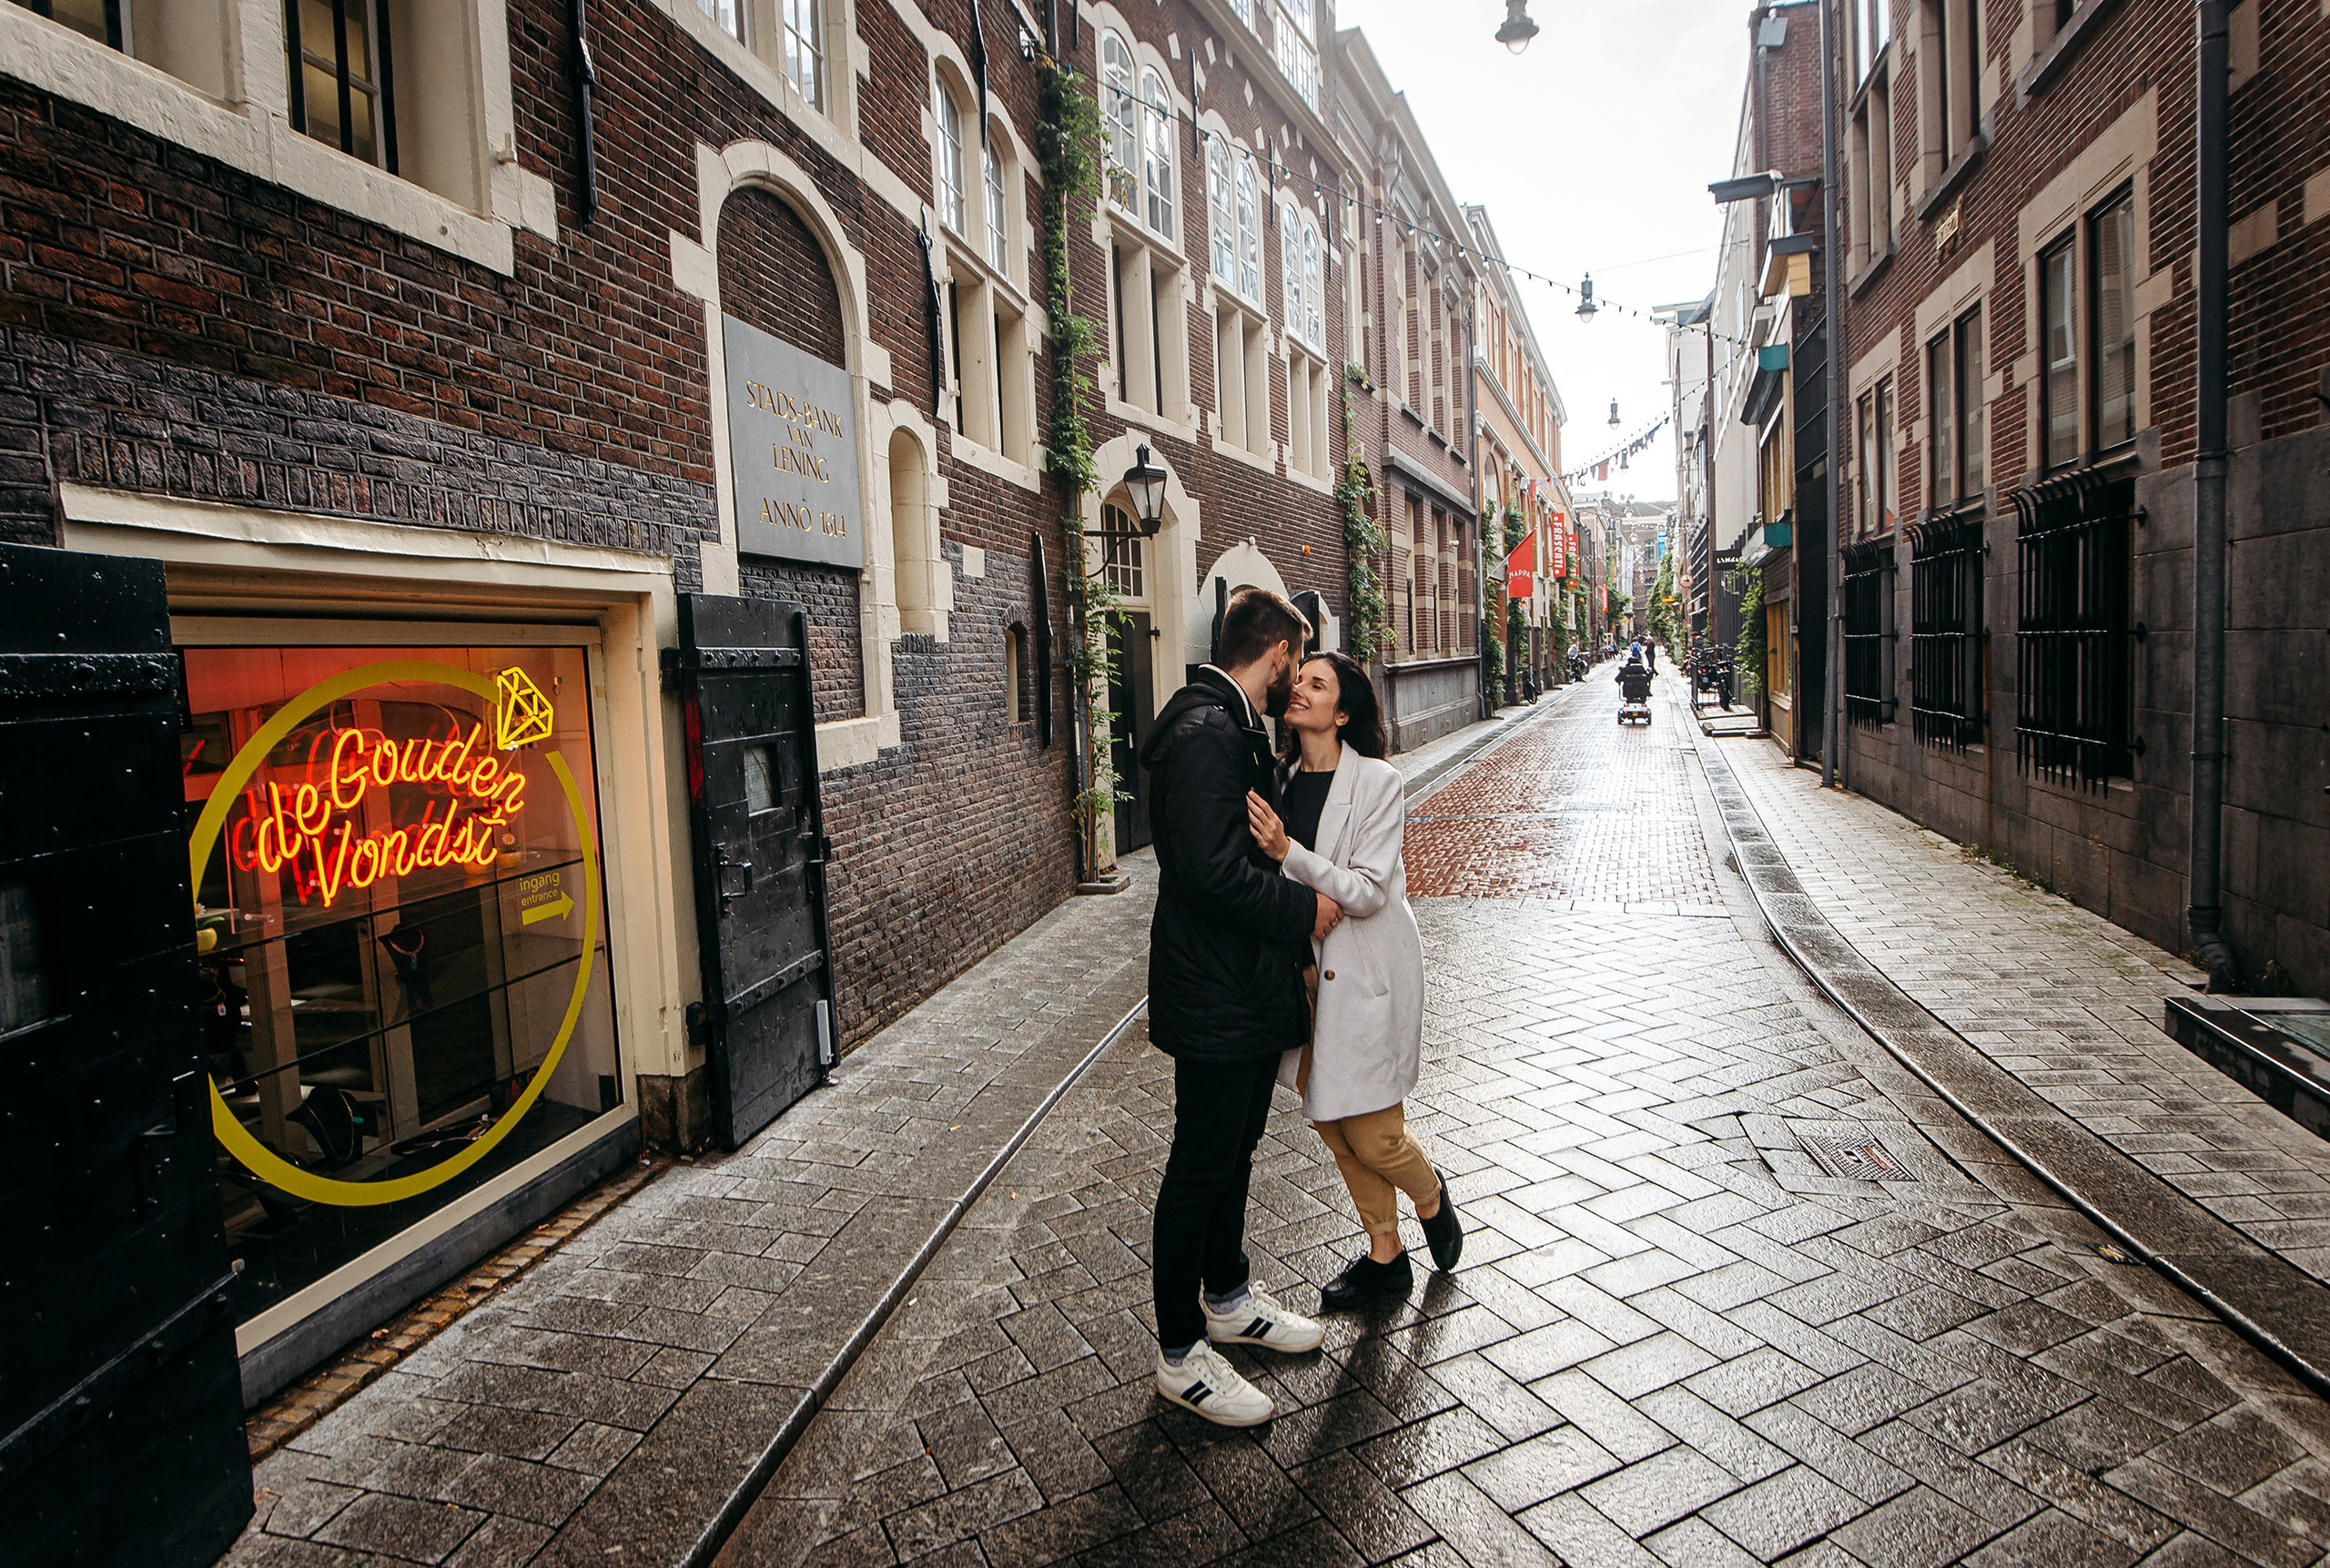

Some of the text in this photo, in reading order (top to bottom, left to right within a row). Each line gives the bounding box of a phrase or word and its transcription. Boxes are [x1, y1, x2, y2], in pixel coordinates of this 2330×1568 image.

[745, 379, 844, 440] STADS-BANK
[786, 424, 815, 451] VAN
[773, 443, 830, 484] LENING
[759, 498, 848, 539] ANNO 1614
[1554, 521, 1564, 569] FRASCATI
[1509, 569, 1531, 579] MAPPA
[258, 721, 526, 874] de Gouden
[311, 797, 507, 908] Vondst
[519, 872, 560, 893] ingang
[521, 888, 558, 906] entrance
